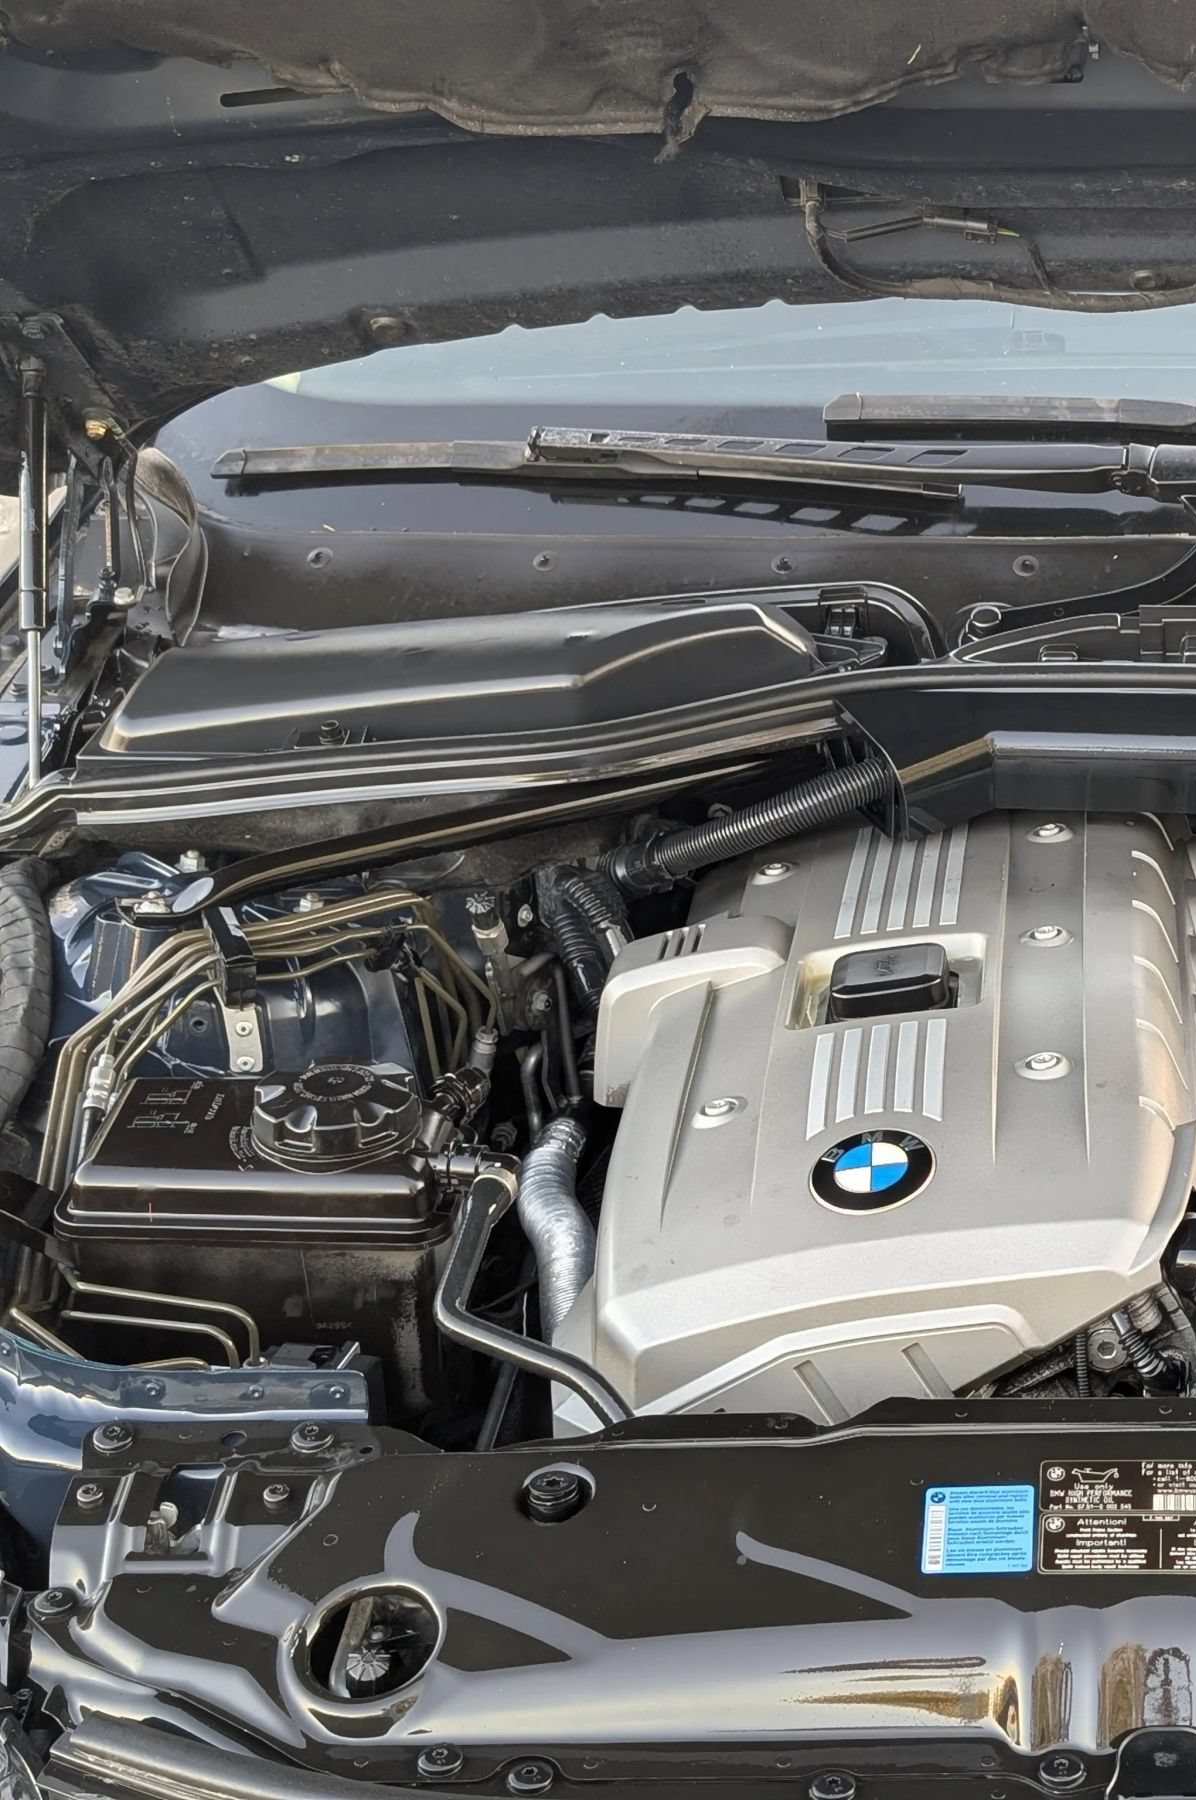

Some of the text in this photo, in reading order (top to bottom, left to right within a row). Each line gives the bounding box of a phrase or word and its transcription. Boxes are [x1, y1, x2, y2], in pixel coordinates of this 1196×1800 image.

[821, 1131, 925, 1163] BMW
[1074, 1482, 1114, 1491] Use only
[1077, 1518, 1127, 1526] Attention!
[1076, 1539, 1127, 1547] Important!
